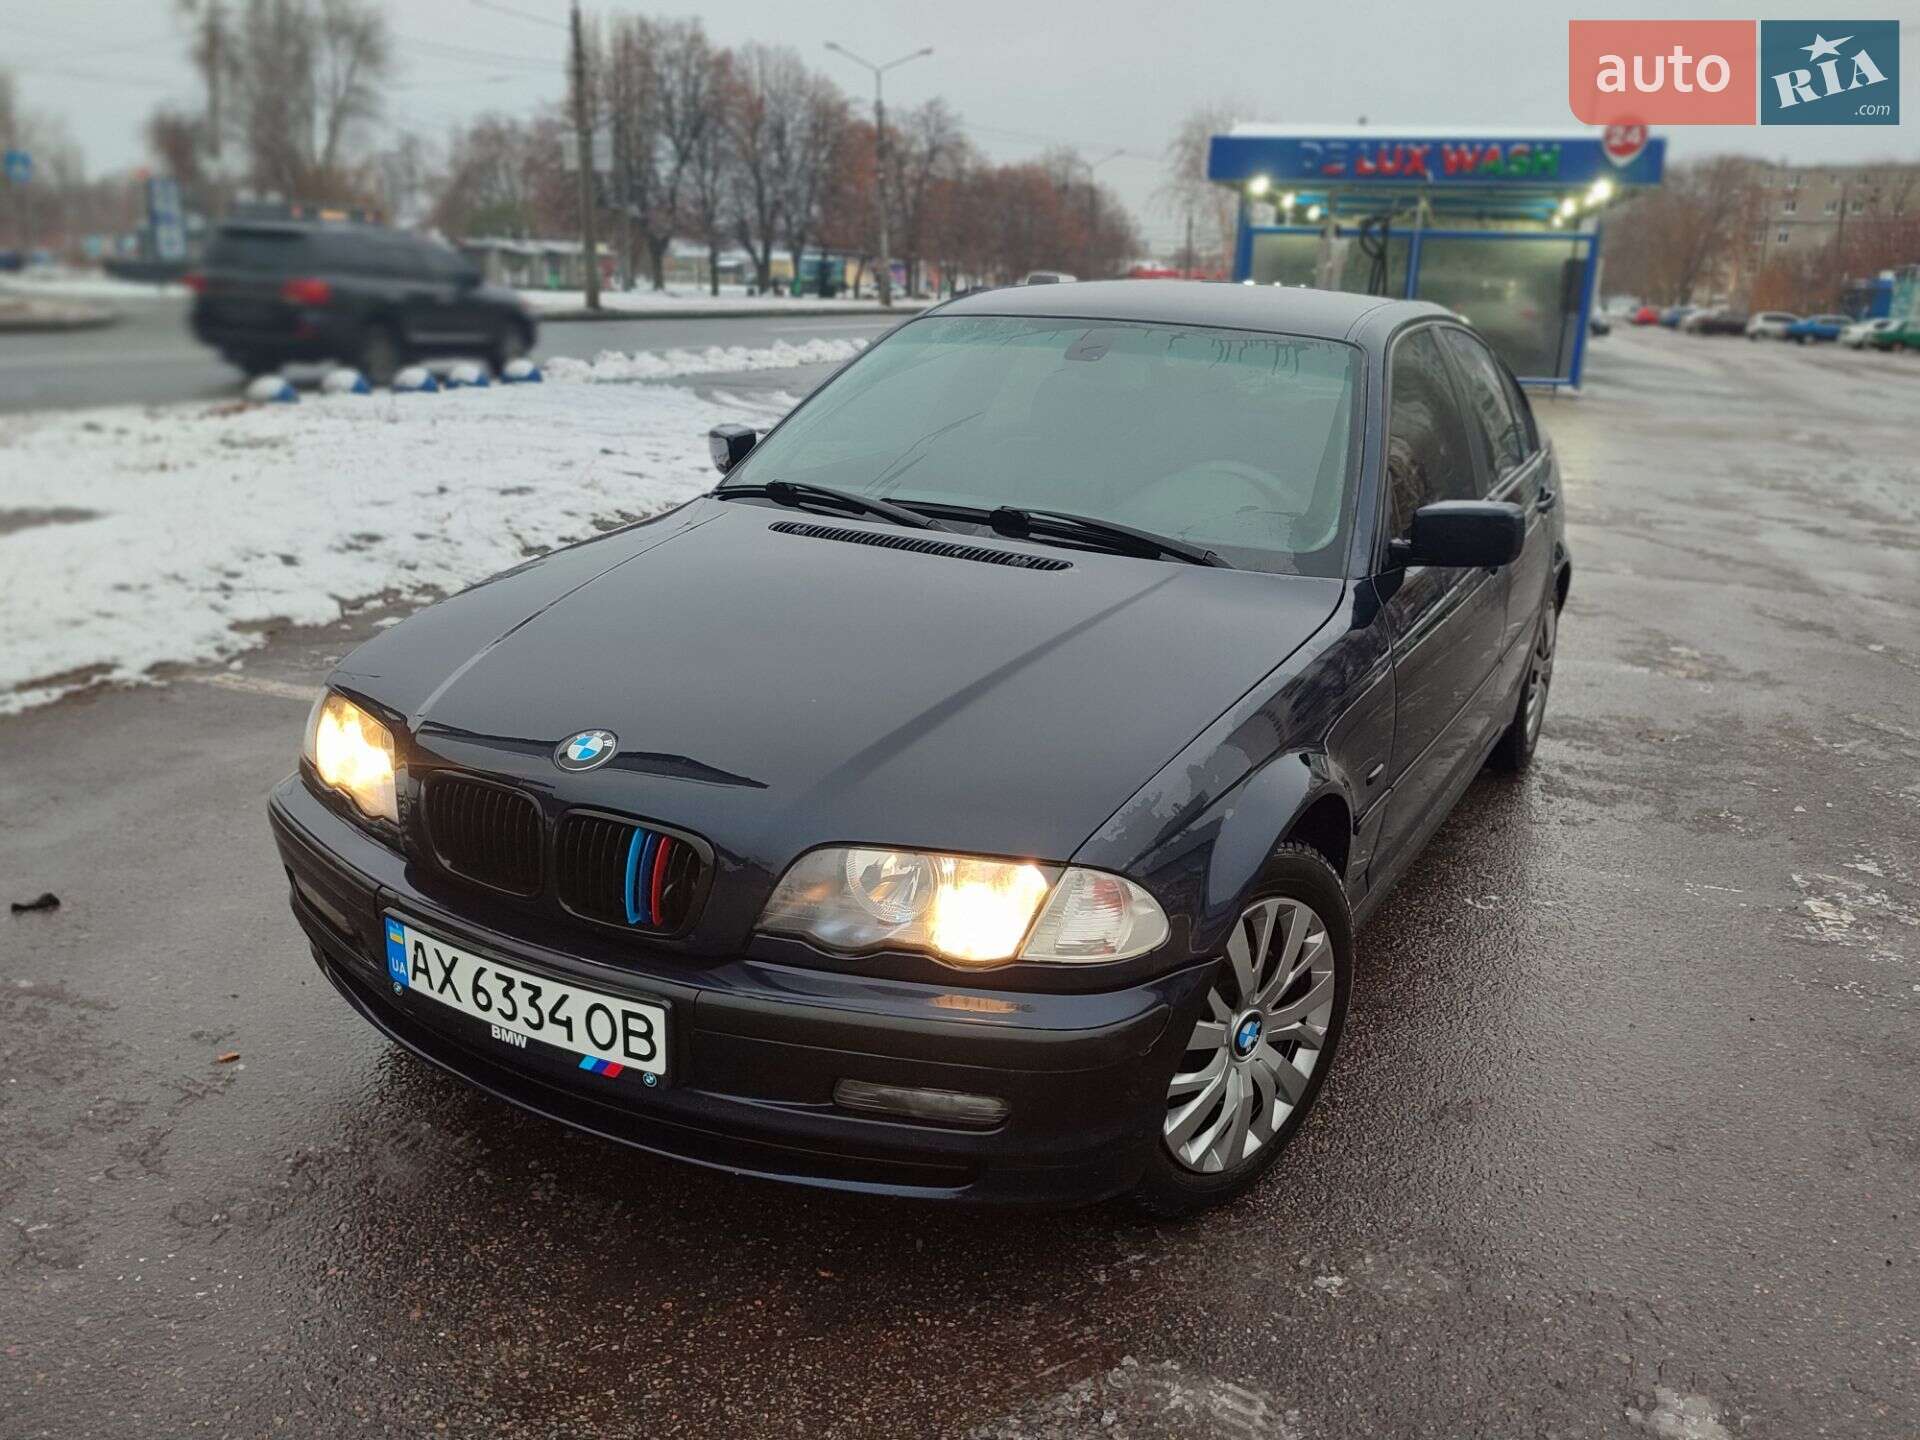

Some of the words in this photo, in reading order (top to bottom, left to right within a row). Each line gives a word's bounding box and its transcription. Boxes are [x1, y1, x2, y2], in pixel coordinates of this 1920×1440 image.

[1355, 143, 1430, 176] LUX
[1442, 143, 1563, 176] WASH
[391, 957, 407, 977] UA
[412, 940, 463, 1003] AX
[471, 966, 574, 1042] 6334
[585, 1002, 657, 1062] OB
[491, 1024, 528, 1049] BMW
